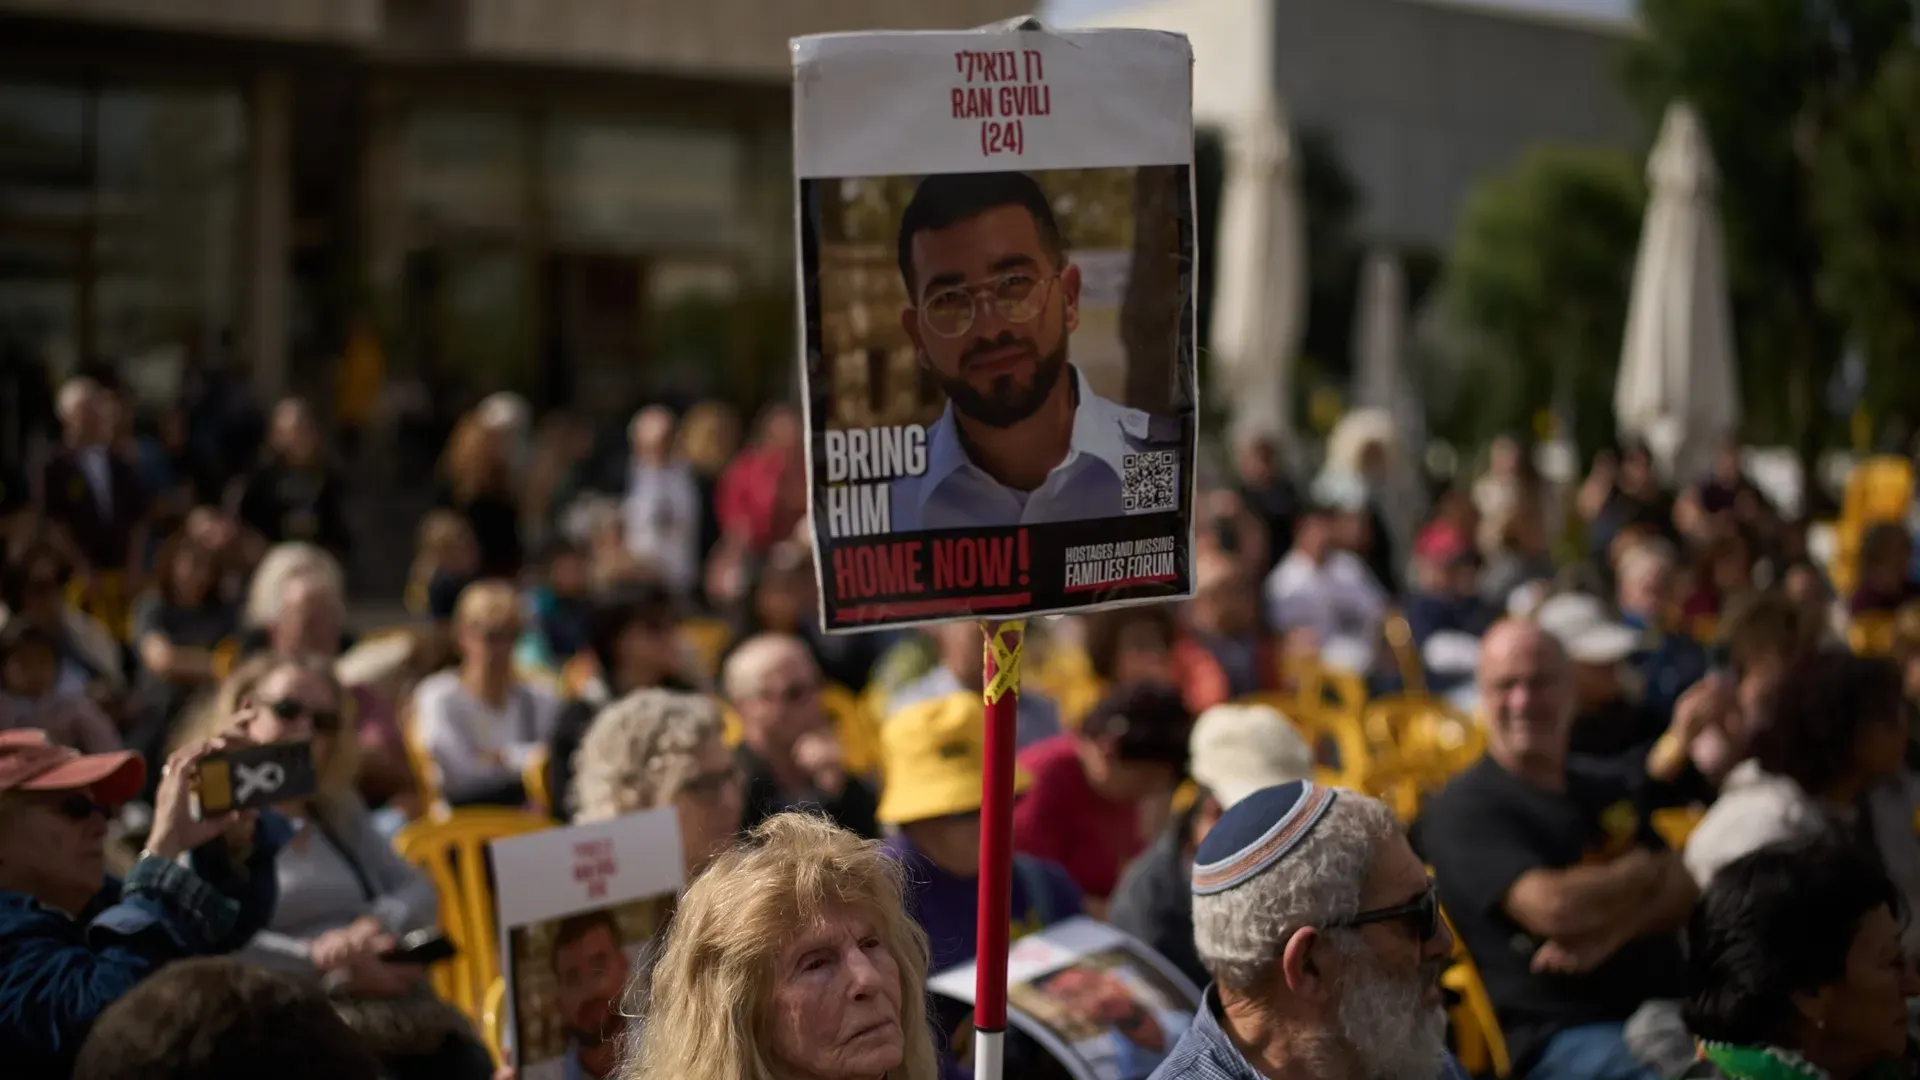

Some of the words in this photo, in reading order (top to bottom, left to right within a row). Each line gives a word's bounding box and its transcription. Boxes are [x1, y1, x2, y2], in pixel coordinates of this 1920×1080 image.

[955, 50, 1018, 83] גואילי
[1023, 50, 1043, 83] רן
[951, 87, 993, 118] RAN
[999, 85, 1050, 117] GVILI
[981, 120, 1024, 157] (24)
[825, 423, 927, 482] BRING
[828, 483, 890, 538] HIM
[833, 541, 925, 599] HOME
[932, 528, 1030, 591] NOW!
[1065, 542, 1114, 562] HOSTAGES
[1114, 540, 1133, 558] AND
[1134, 535, 1175, 555] MISSING
[1065, 557, 1125, 588] FAMILIES
[1126, 551, 1175, 579] FORUM
